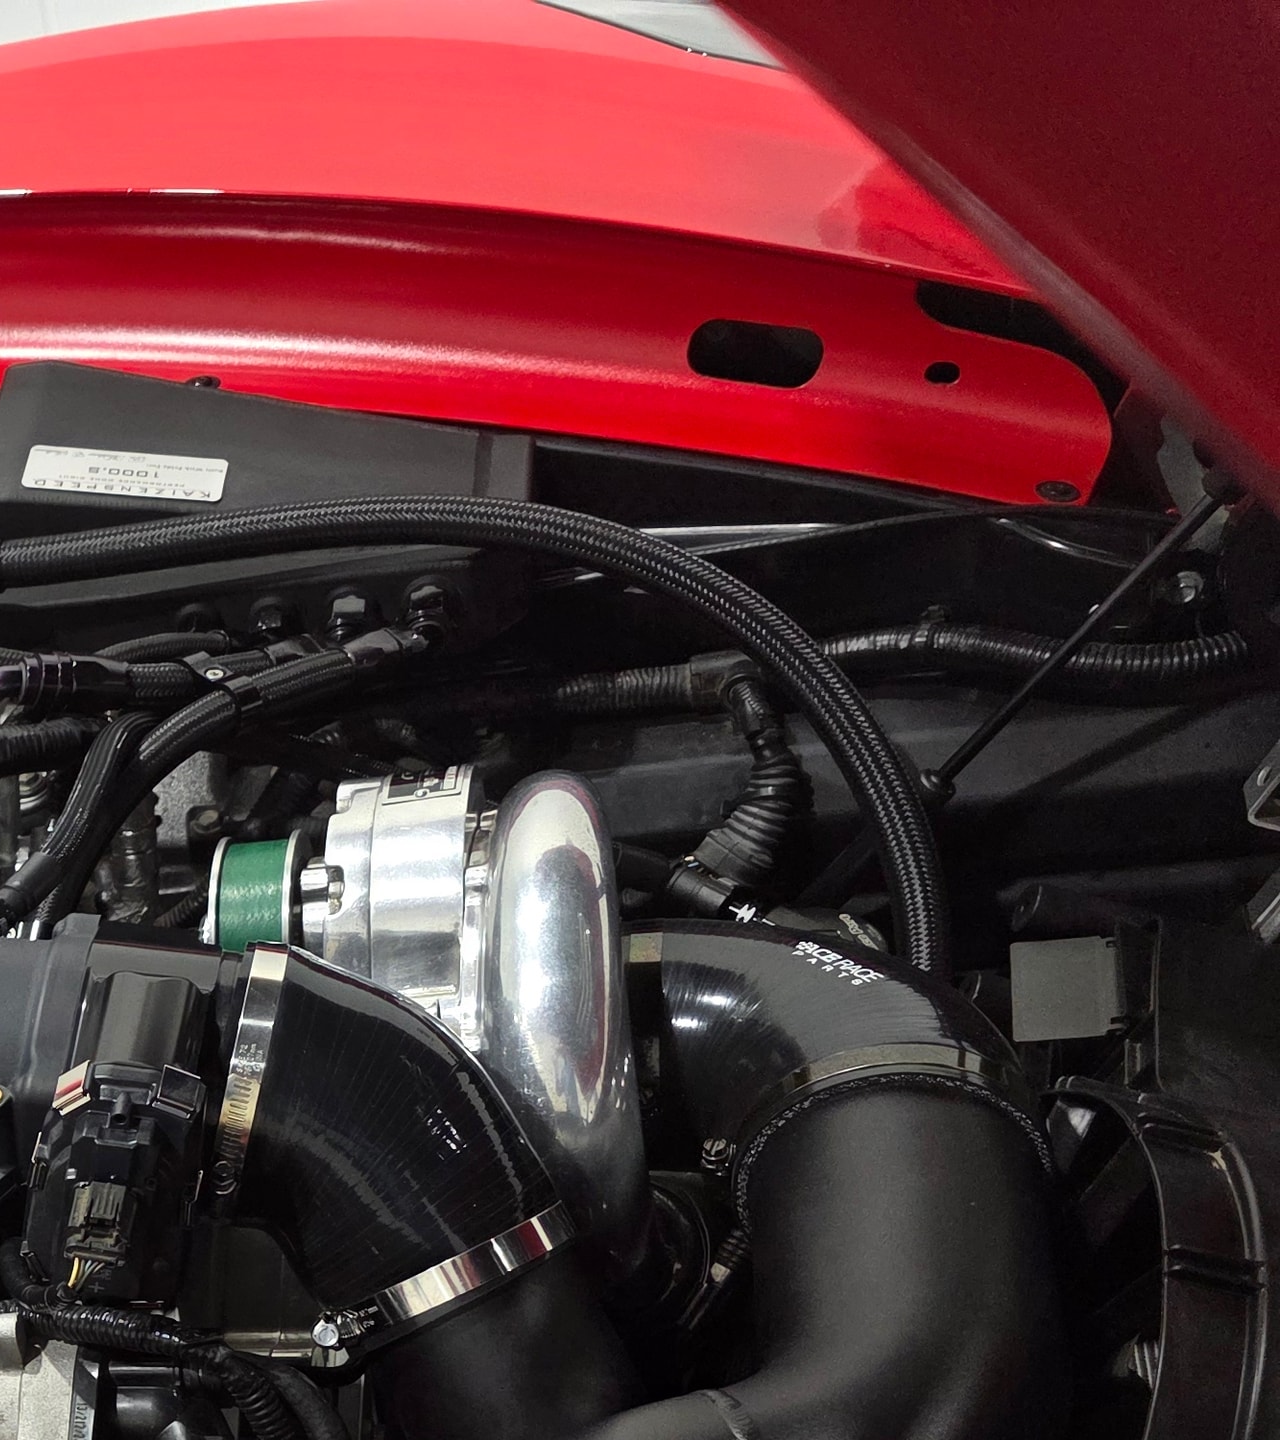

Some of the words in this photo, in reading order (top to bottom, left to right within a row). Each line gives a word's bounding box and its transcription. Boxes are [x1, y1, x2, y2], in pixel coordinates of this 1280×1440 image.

[34, 479, 211, 499] KAIZENSPEED
[792, 950, 864, 986] PARTS
[833, 959, 885, 983] RACE
